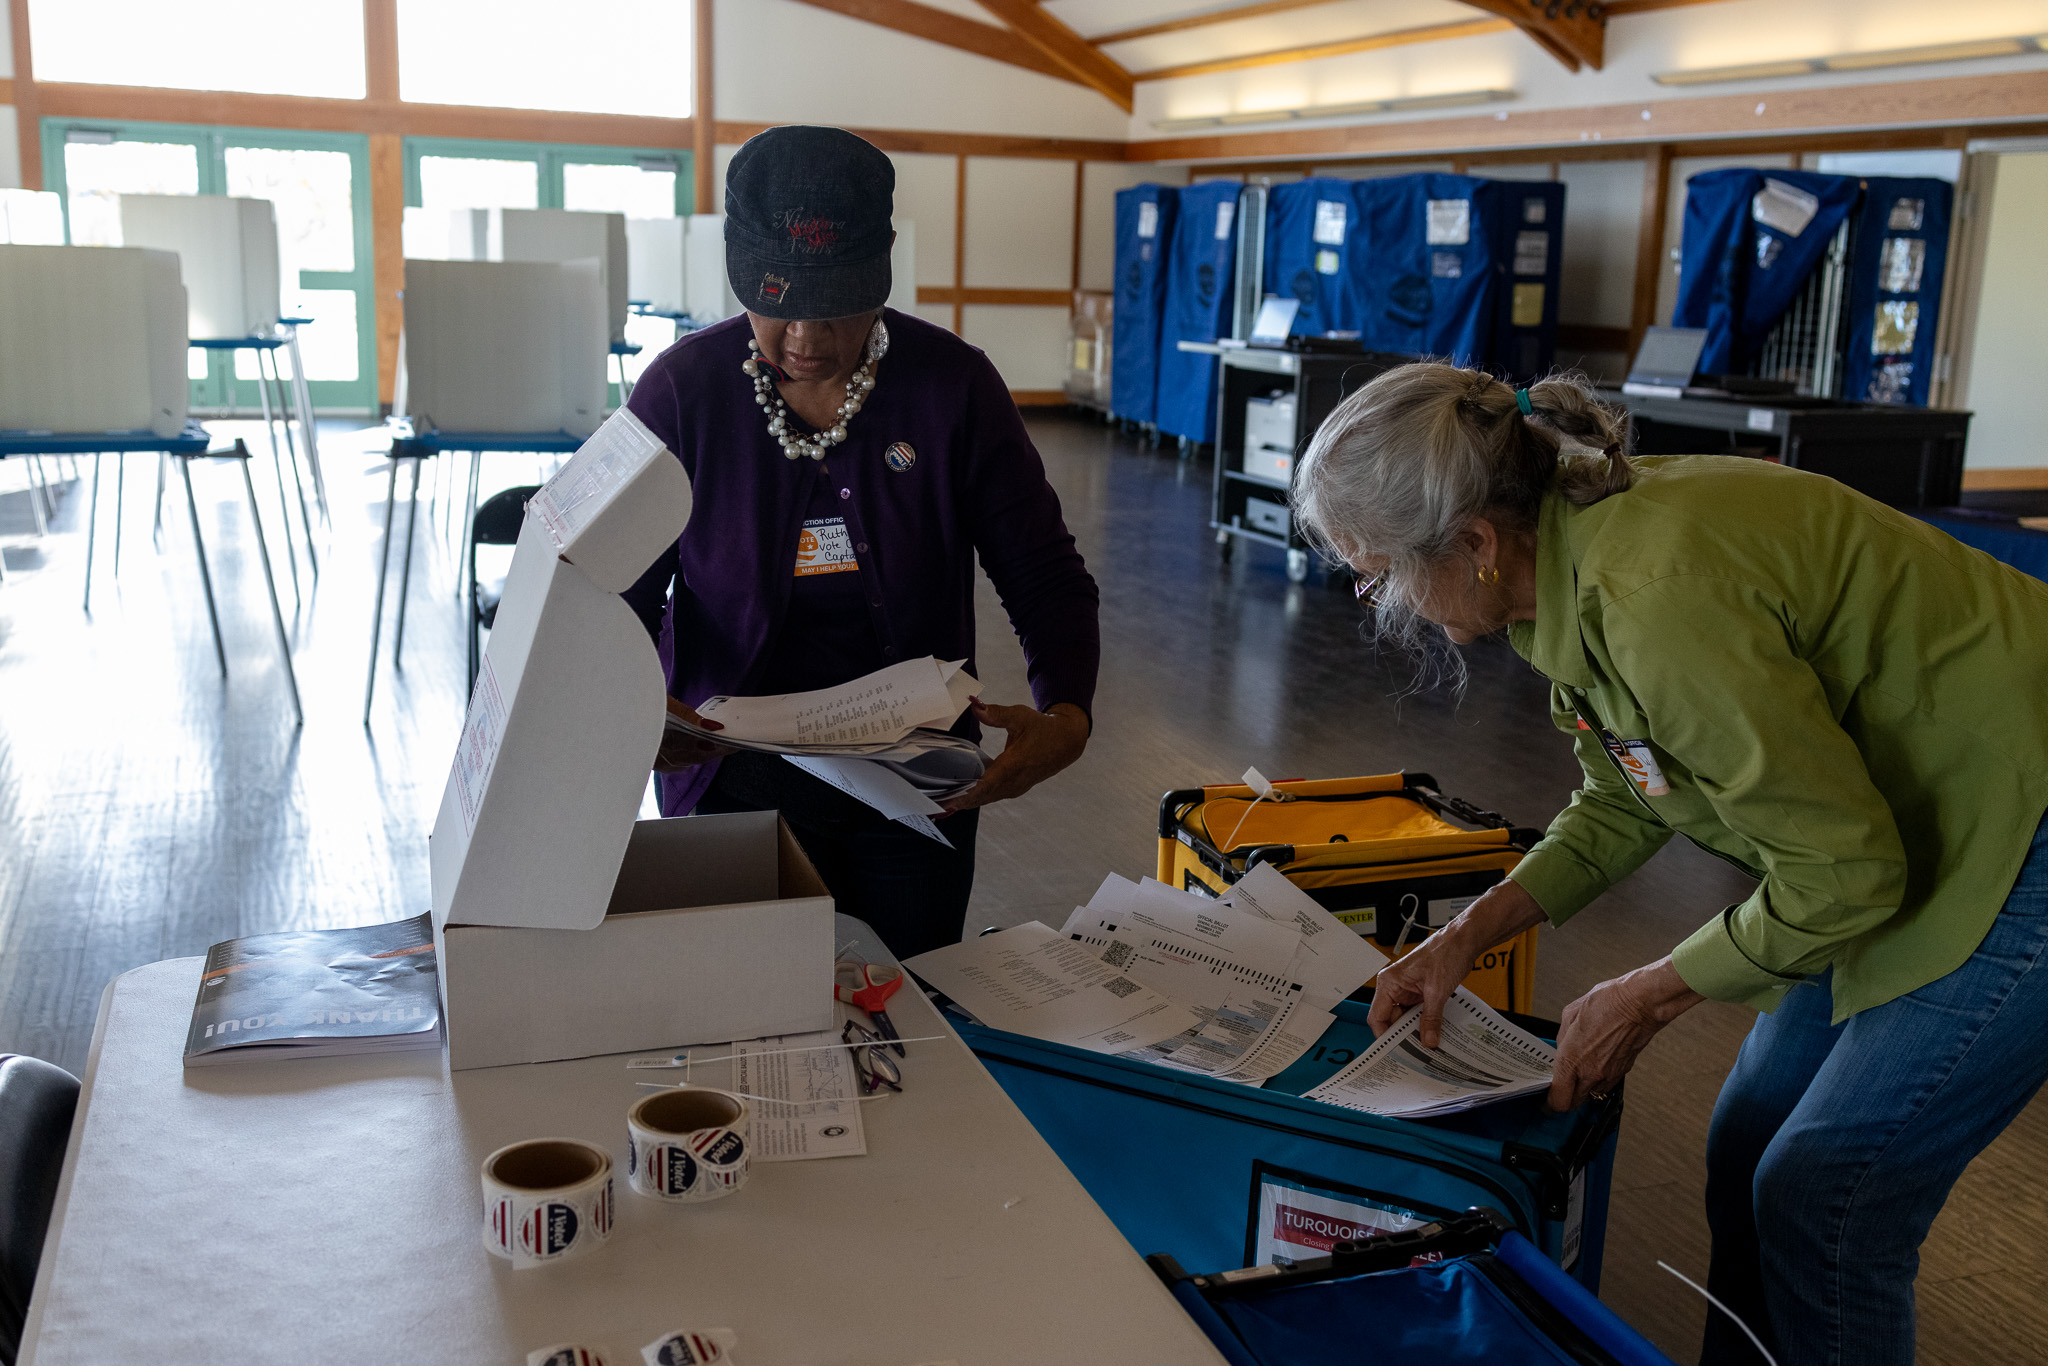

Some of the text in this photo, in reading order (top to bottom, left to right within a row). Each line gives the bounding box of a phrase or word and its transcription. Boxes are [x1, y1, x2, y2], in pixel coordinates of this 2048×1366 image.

[825, 516, 844, 524] OFFIC
[800, 536, 814, 544] OTE
[816, 528, 848, 541] Ruth
[824, 549, 856, 564] Capta
[1197, 914, 1230, 929] OFFICIAL BALLOT
[1298, 910, 1324, 932] OFFICIAL BALLOT
[1338, 912, 1374, 924] CENTER
[204, 1007, 428, 1038] THANK YOU!
[1485, 1029, 1503, 1041] OFFICIAL
[1502, 1040, 1519, 1050] BALLOT
[740, 1069, 748, 1084] OFFICIAL
[711, 1142, 736, 1164] Voted
[674, 1160, 686, 1190] Voted
[554, 1214, 568, 1248] Voted
[1304, 1238, 1330, 1250] Closing
